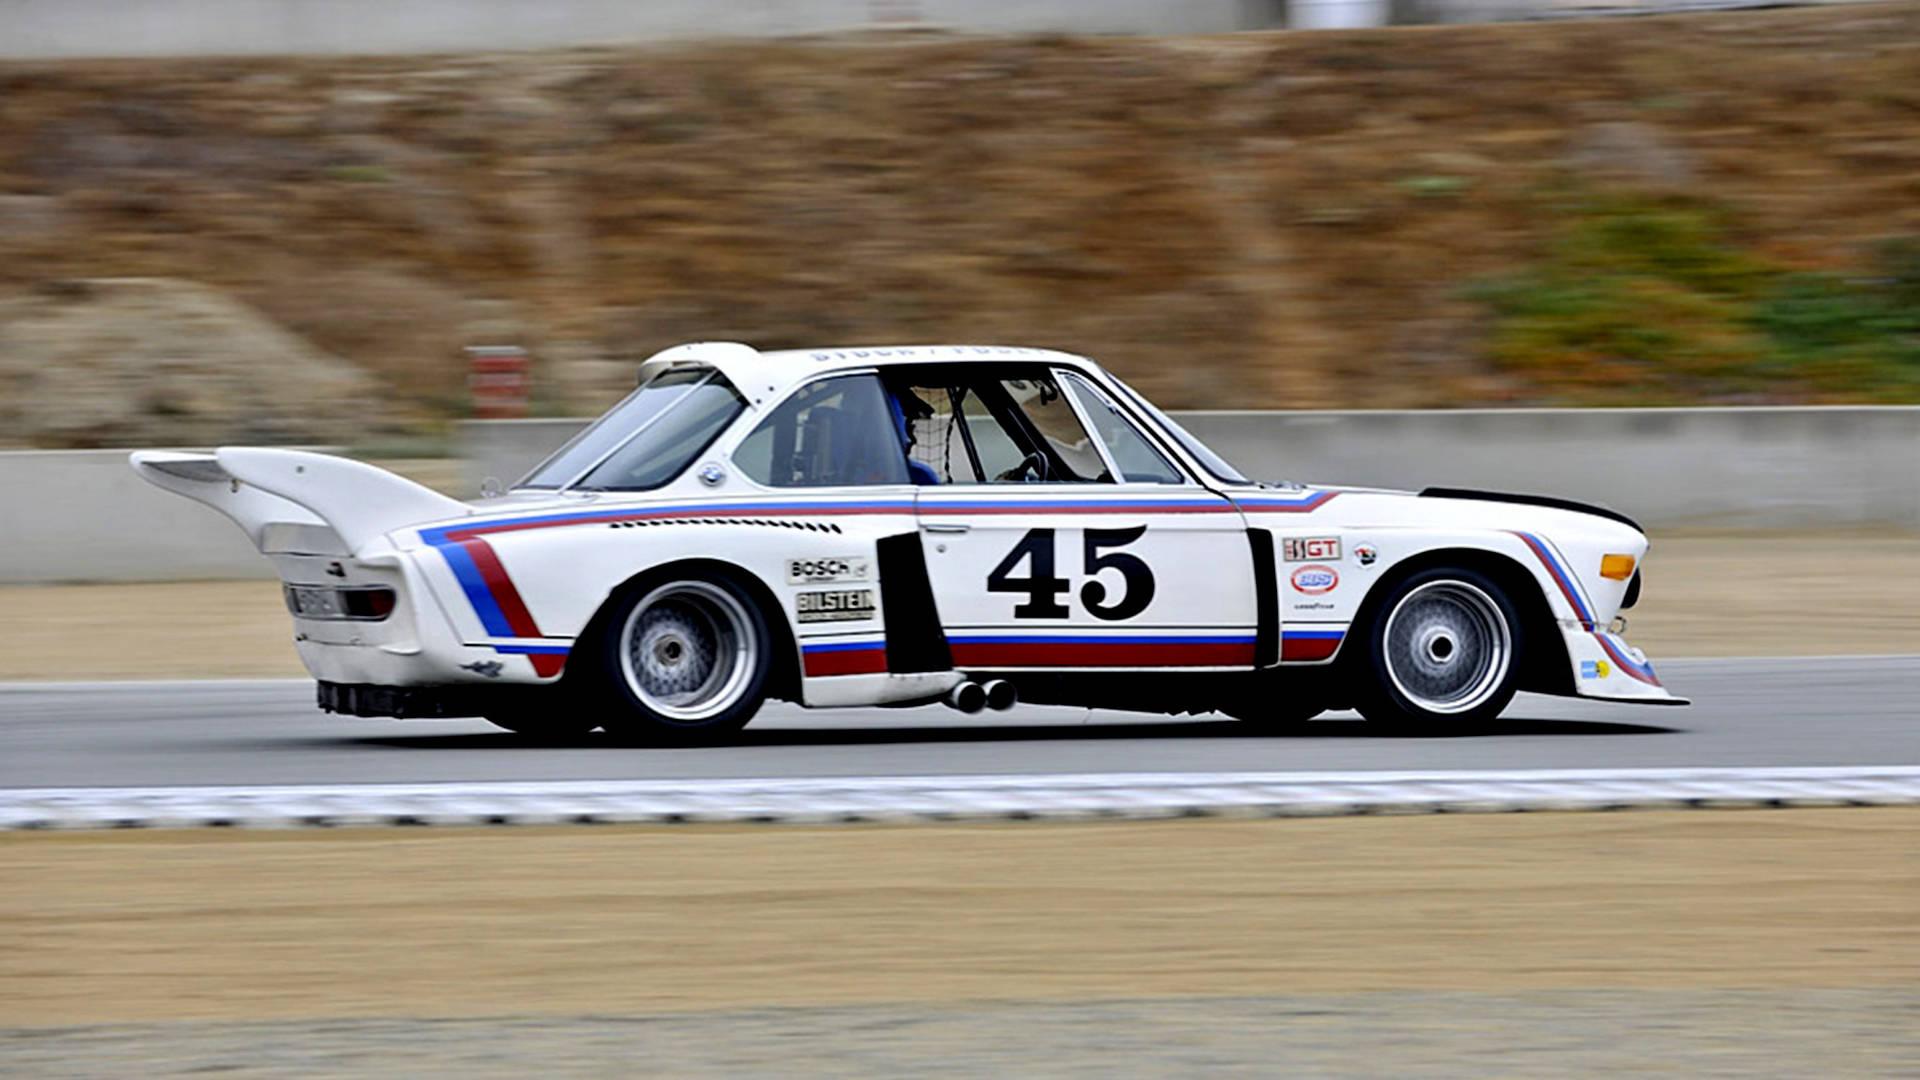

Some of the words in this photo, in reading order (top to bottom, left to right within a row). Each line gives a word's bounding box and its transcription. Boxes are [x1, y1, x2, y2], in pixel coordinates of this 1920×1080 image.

[1307, 540, 1337, 557] GT
[791, 560, 849, 577] BOSCH
[987, 524, 1155, 621] 45
[798, 593, 874, 611] BILSTEIN
